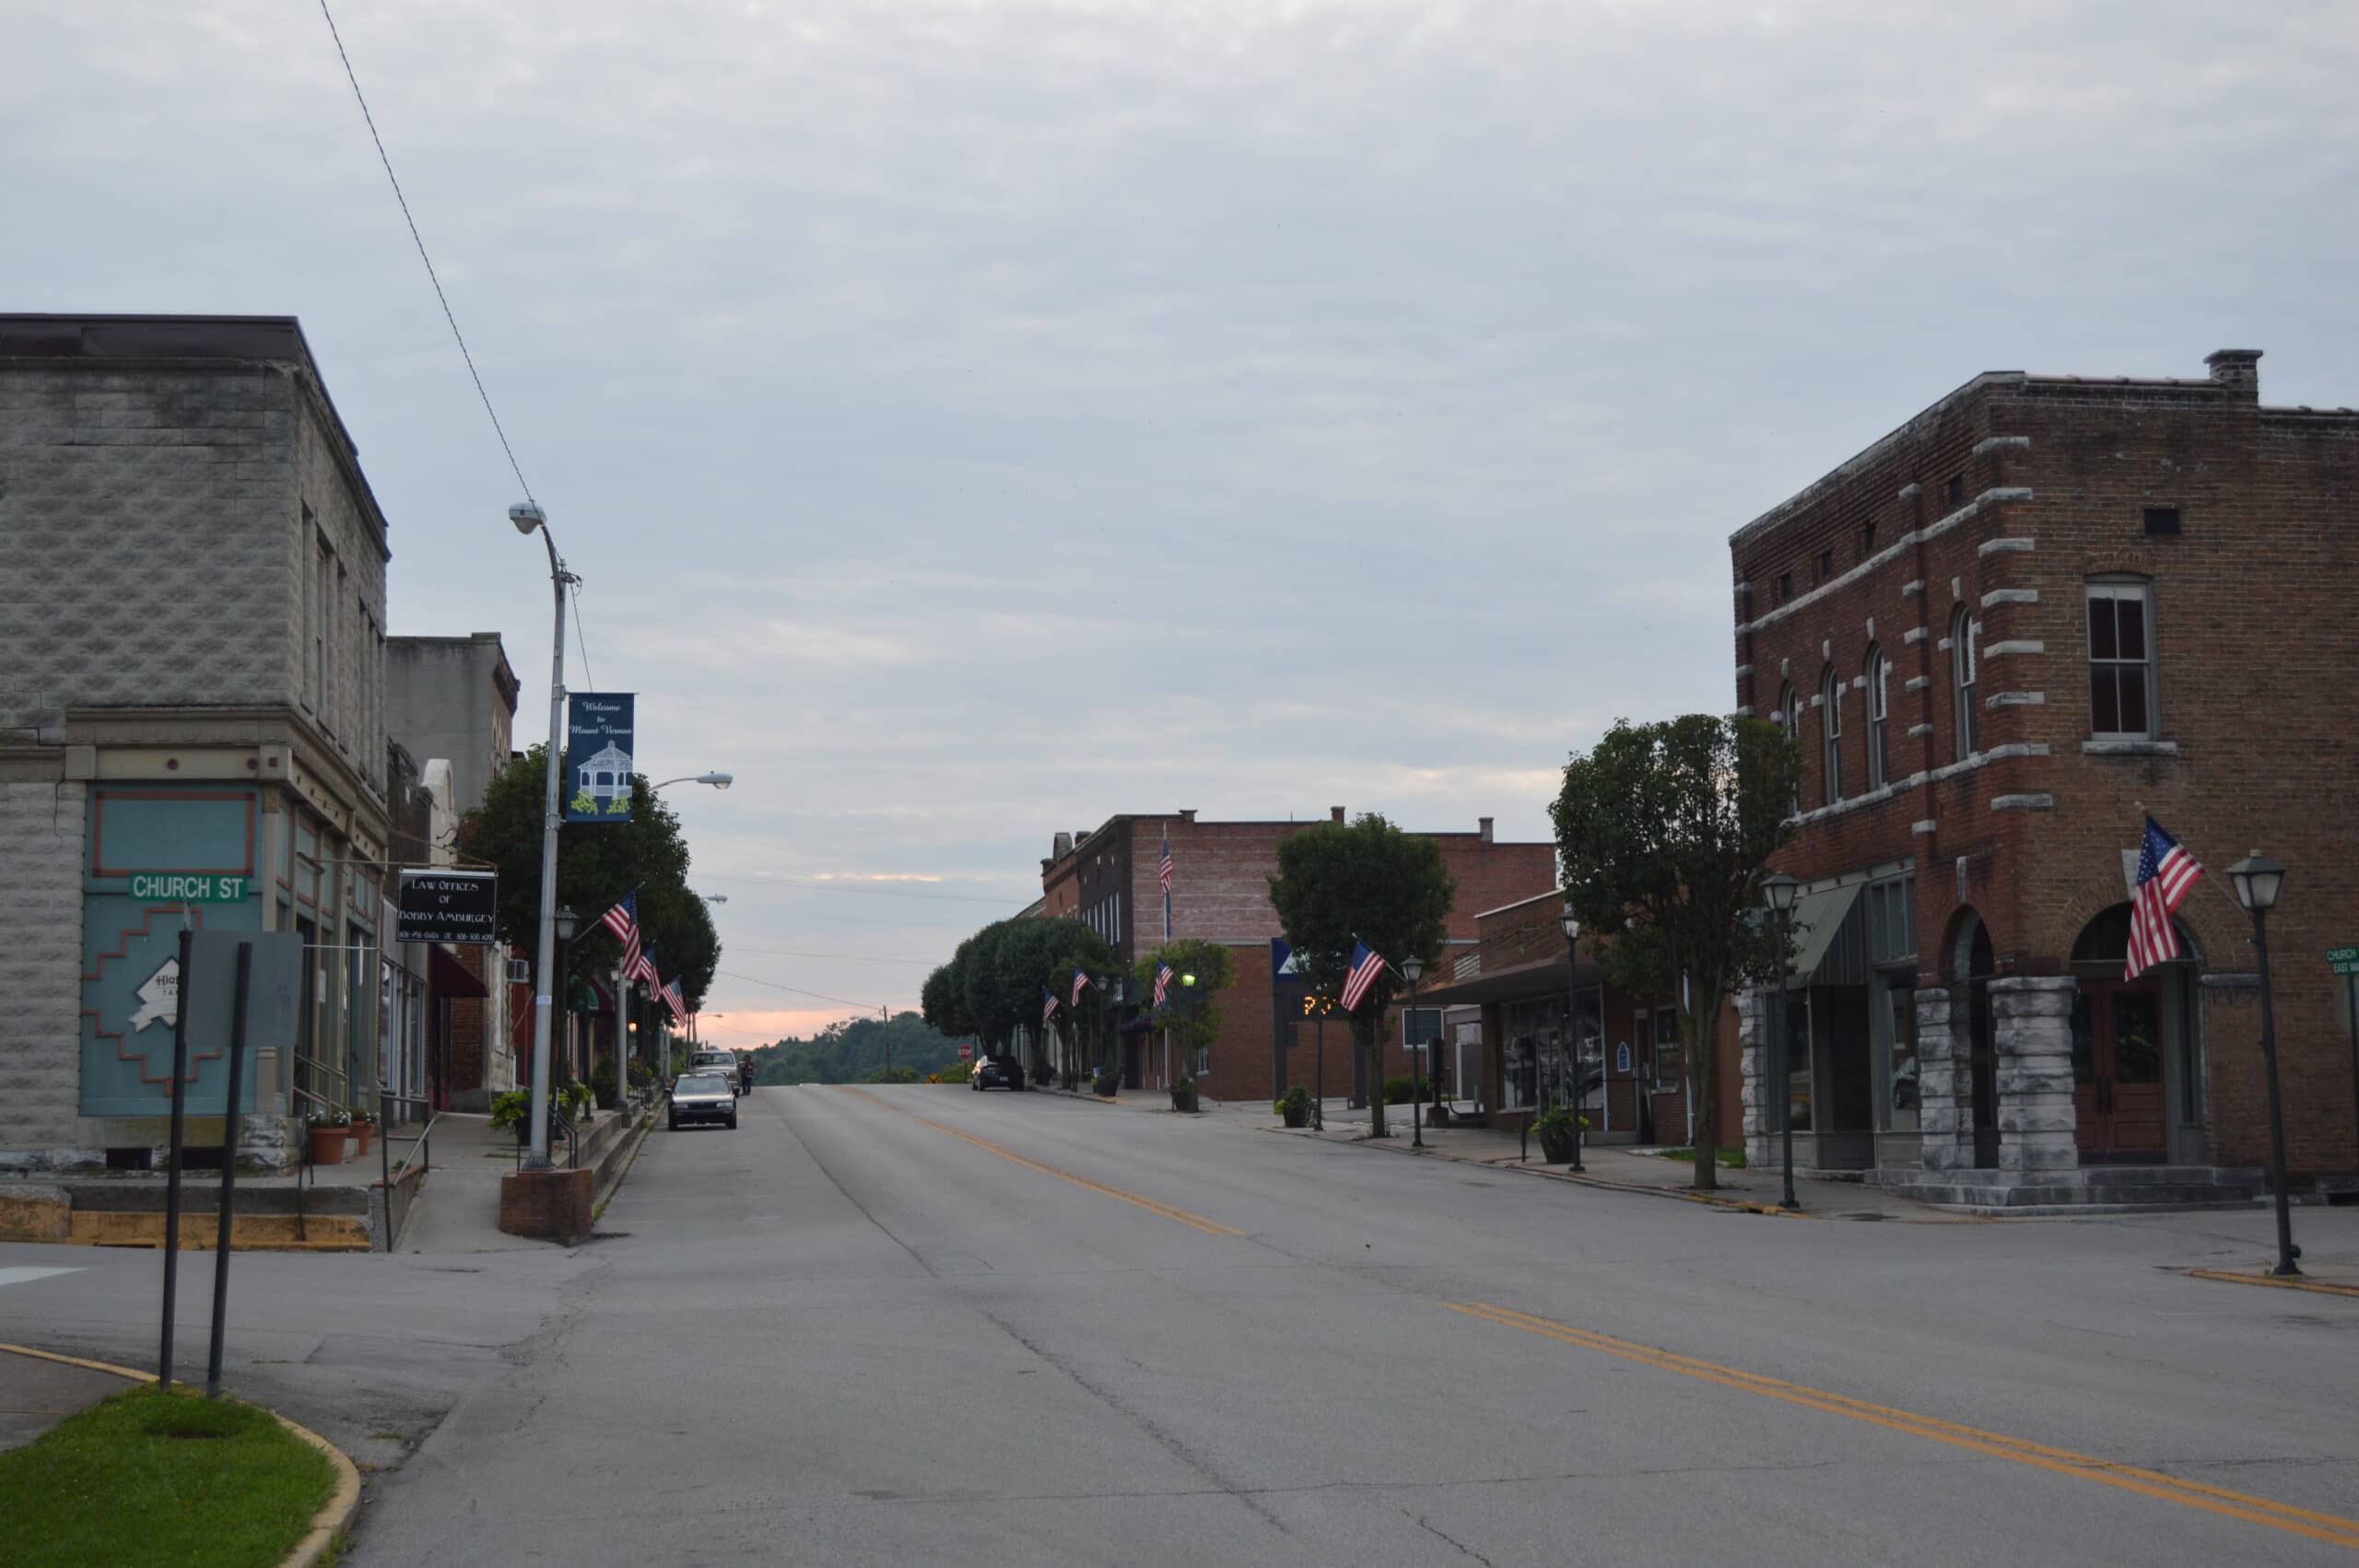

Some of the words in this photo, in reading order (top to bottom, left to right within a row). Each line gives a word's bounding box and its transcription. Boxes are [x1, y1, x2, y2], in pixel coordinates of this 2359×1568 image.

[582, 701, 621, 712] Welcome
[596, 715, 606, 723] to
[570, 724, 599, 735] Mount
[600, 724, 633, 735] Vernon
[133, 875, 210, 898] CHURCH
[219, 877, 243, 899] ST
[2327, 948, 2356, 961] CHURCH
